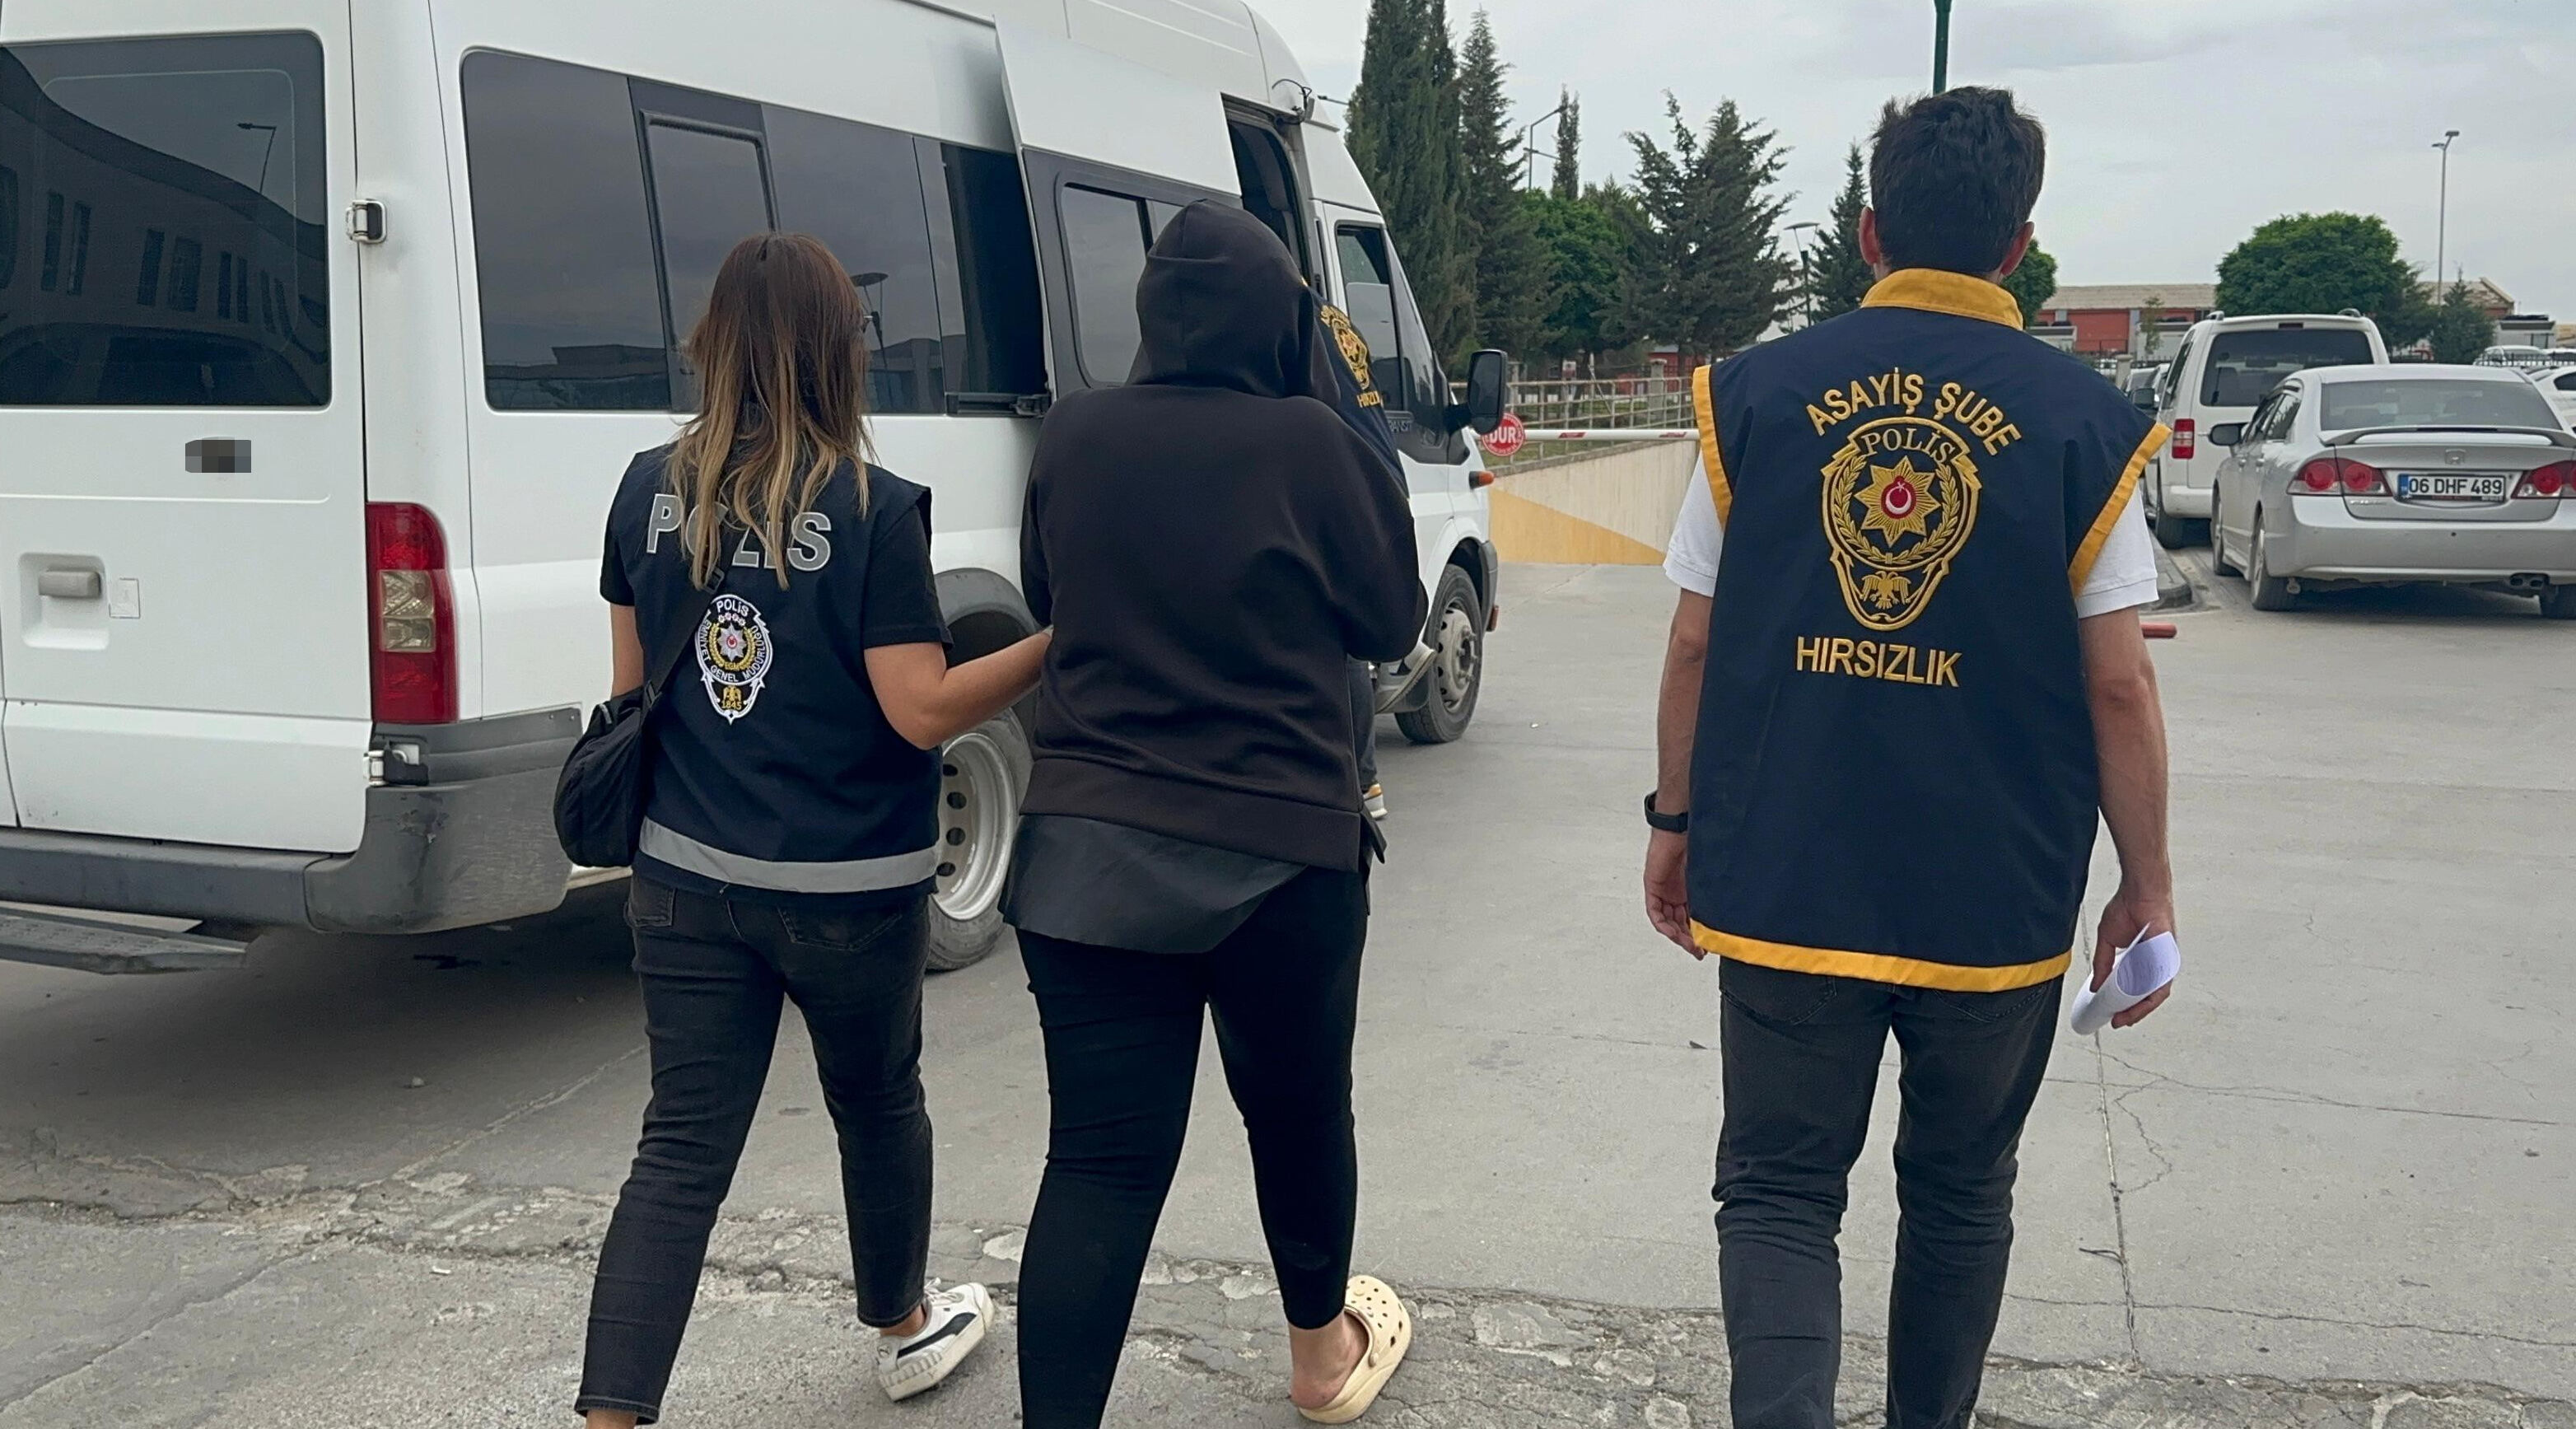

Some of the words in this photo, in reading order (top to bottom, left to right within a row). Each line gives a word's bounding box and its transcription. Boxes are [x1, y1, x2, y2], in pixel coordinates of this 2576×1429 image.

[1806, 367, 1924, 437] ASAYİŞ
[1934, 381, 2022, 456] ŞUBE
[1861, 428, 1956, 463] POLİS
[2409, 479, 2429, 493] 06
[2434, 479, 2468, 494] DHF
[2471, 479, 2503, 494] 489
[1795, 636, 1963, 688] HIRSIZLIK
[721, 700, 742, 710] 1845
